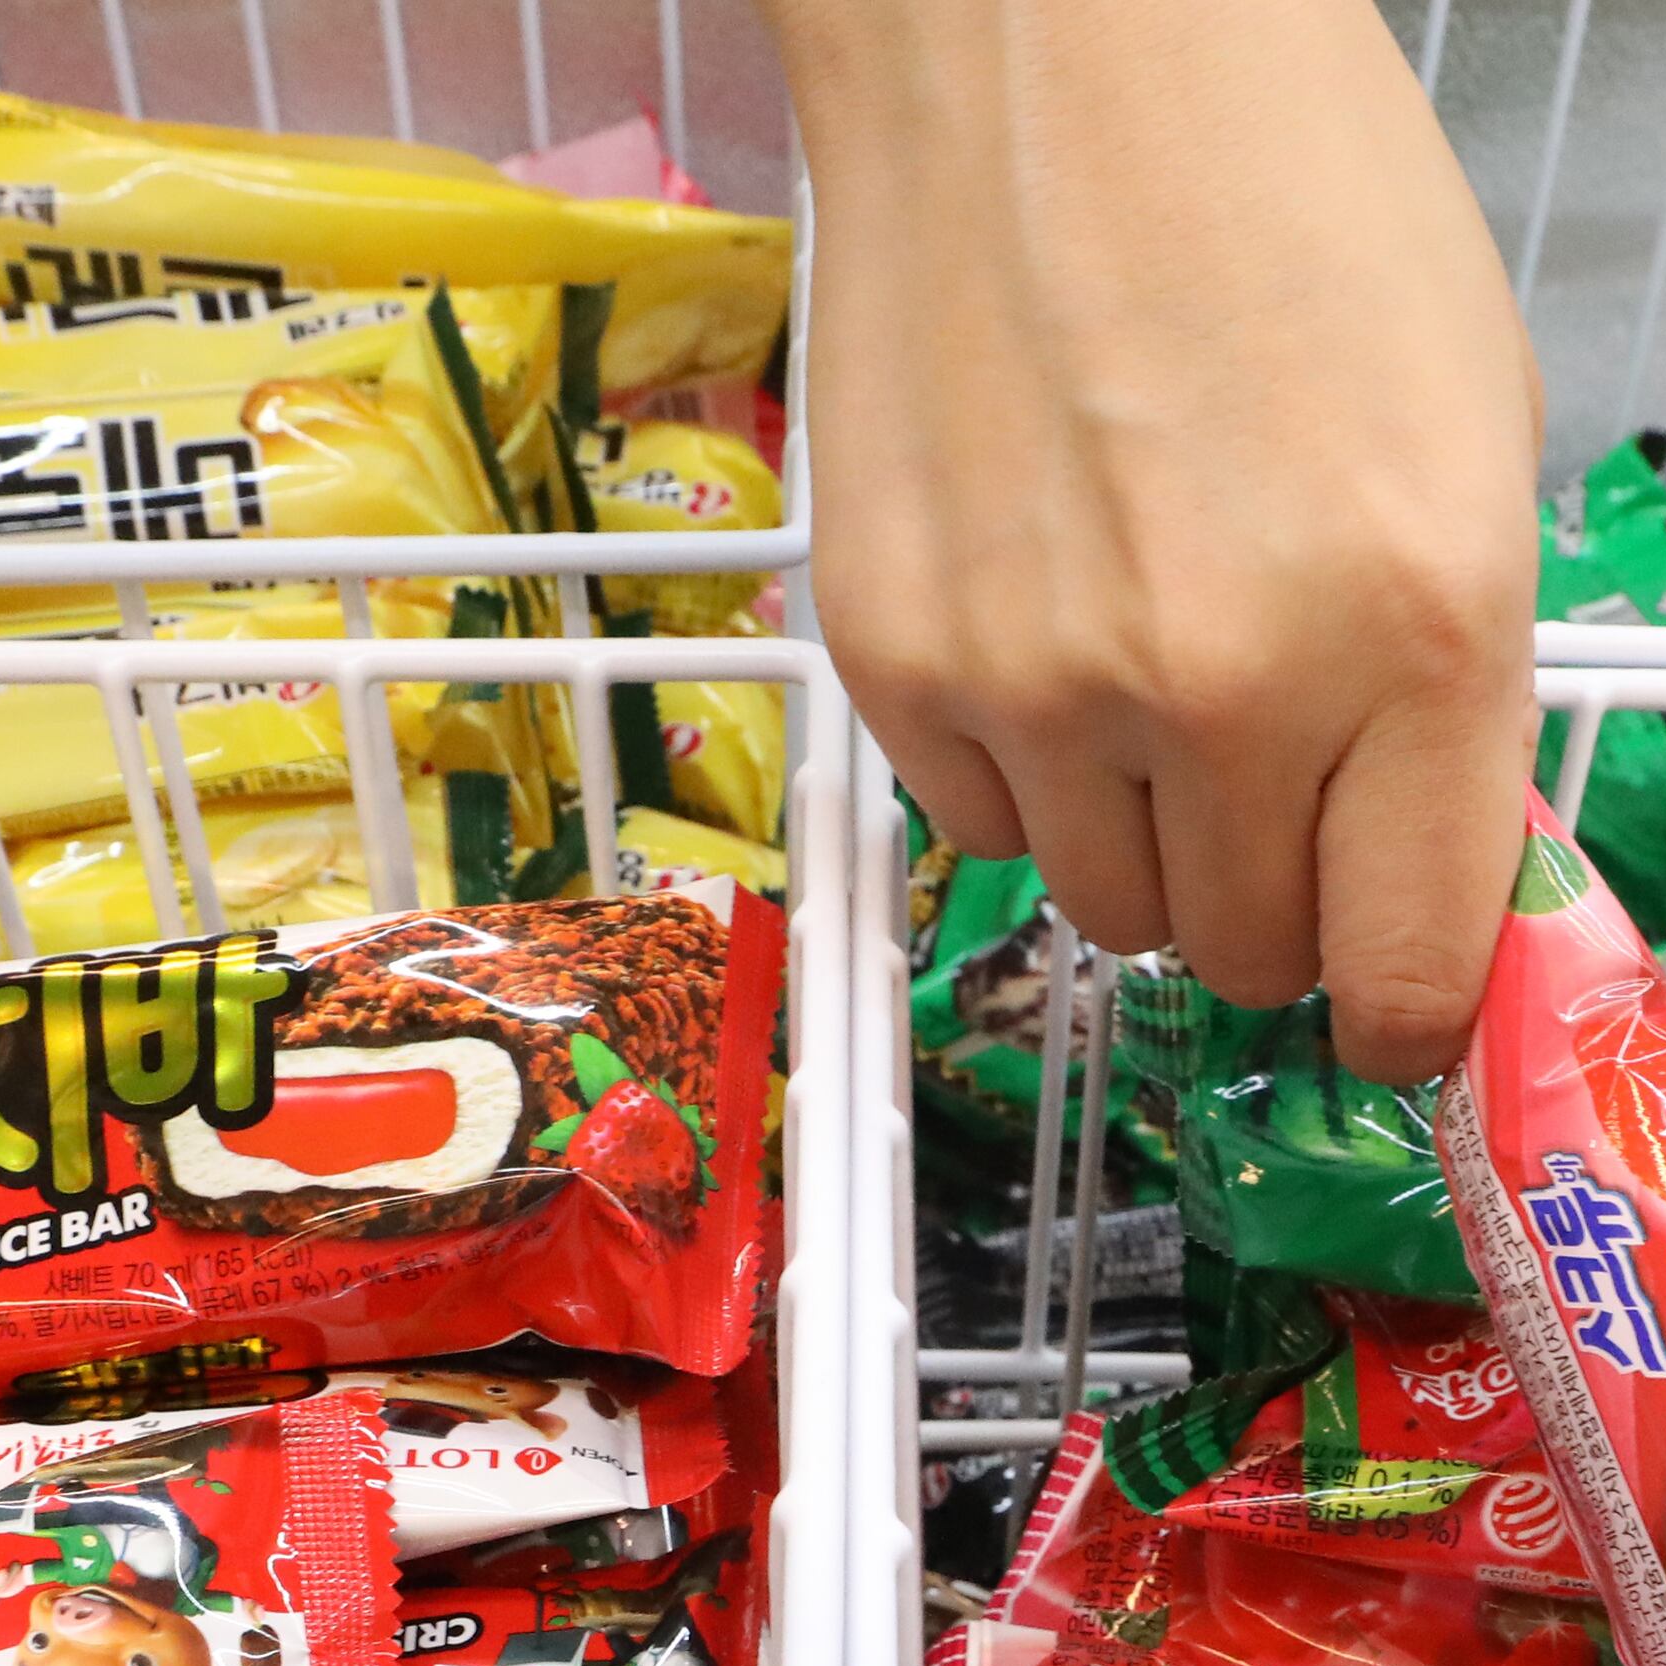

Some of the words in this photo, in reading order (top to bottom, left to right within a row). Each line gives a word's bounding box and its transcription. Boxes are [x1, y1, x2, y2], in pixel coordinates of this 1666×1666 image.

[60, 1197, 151, 1251] BAR
[123, 1263, 155, 1289] 70
[393, 1446, 500, 1470] LOT
[399, 1618, 478, 1648] CRI
